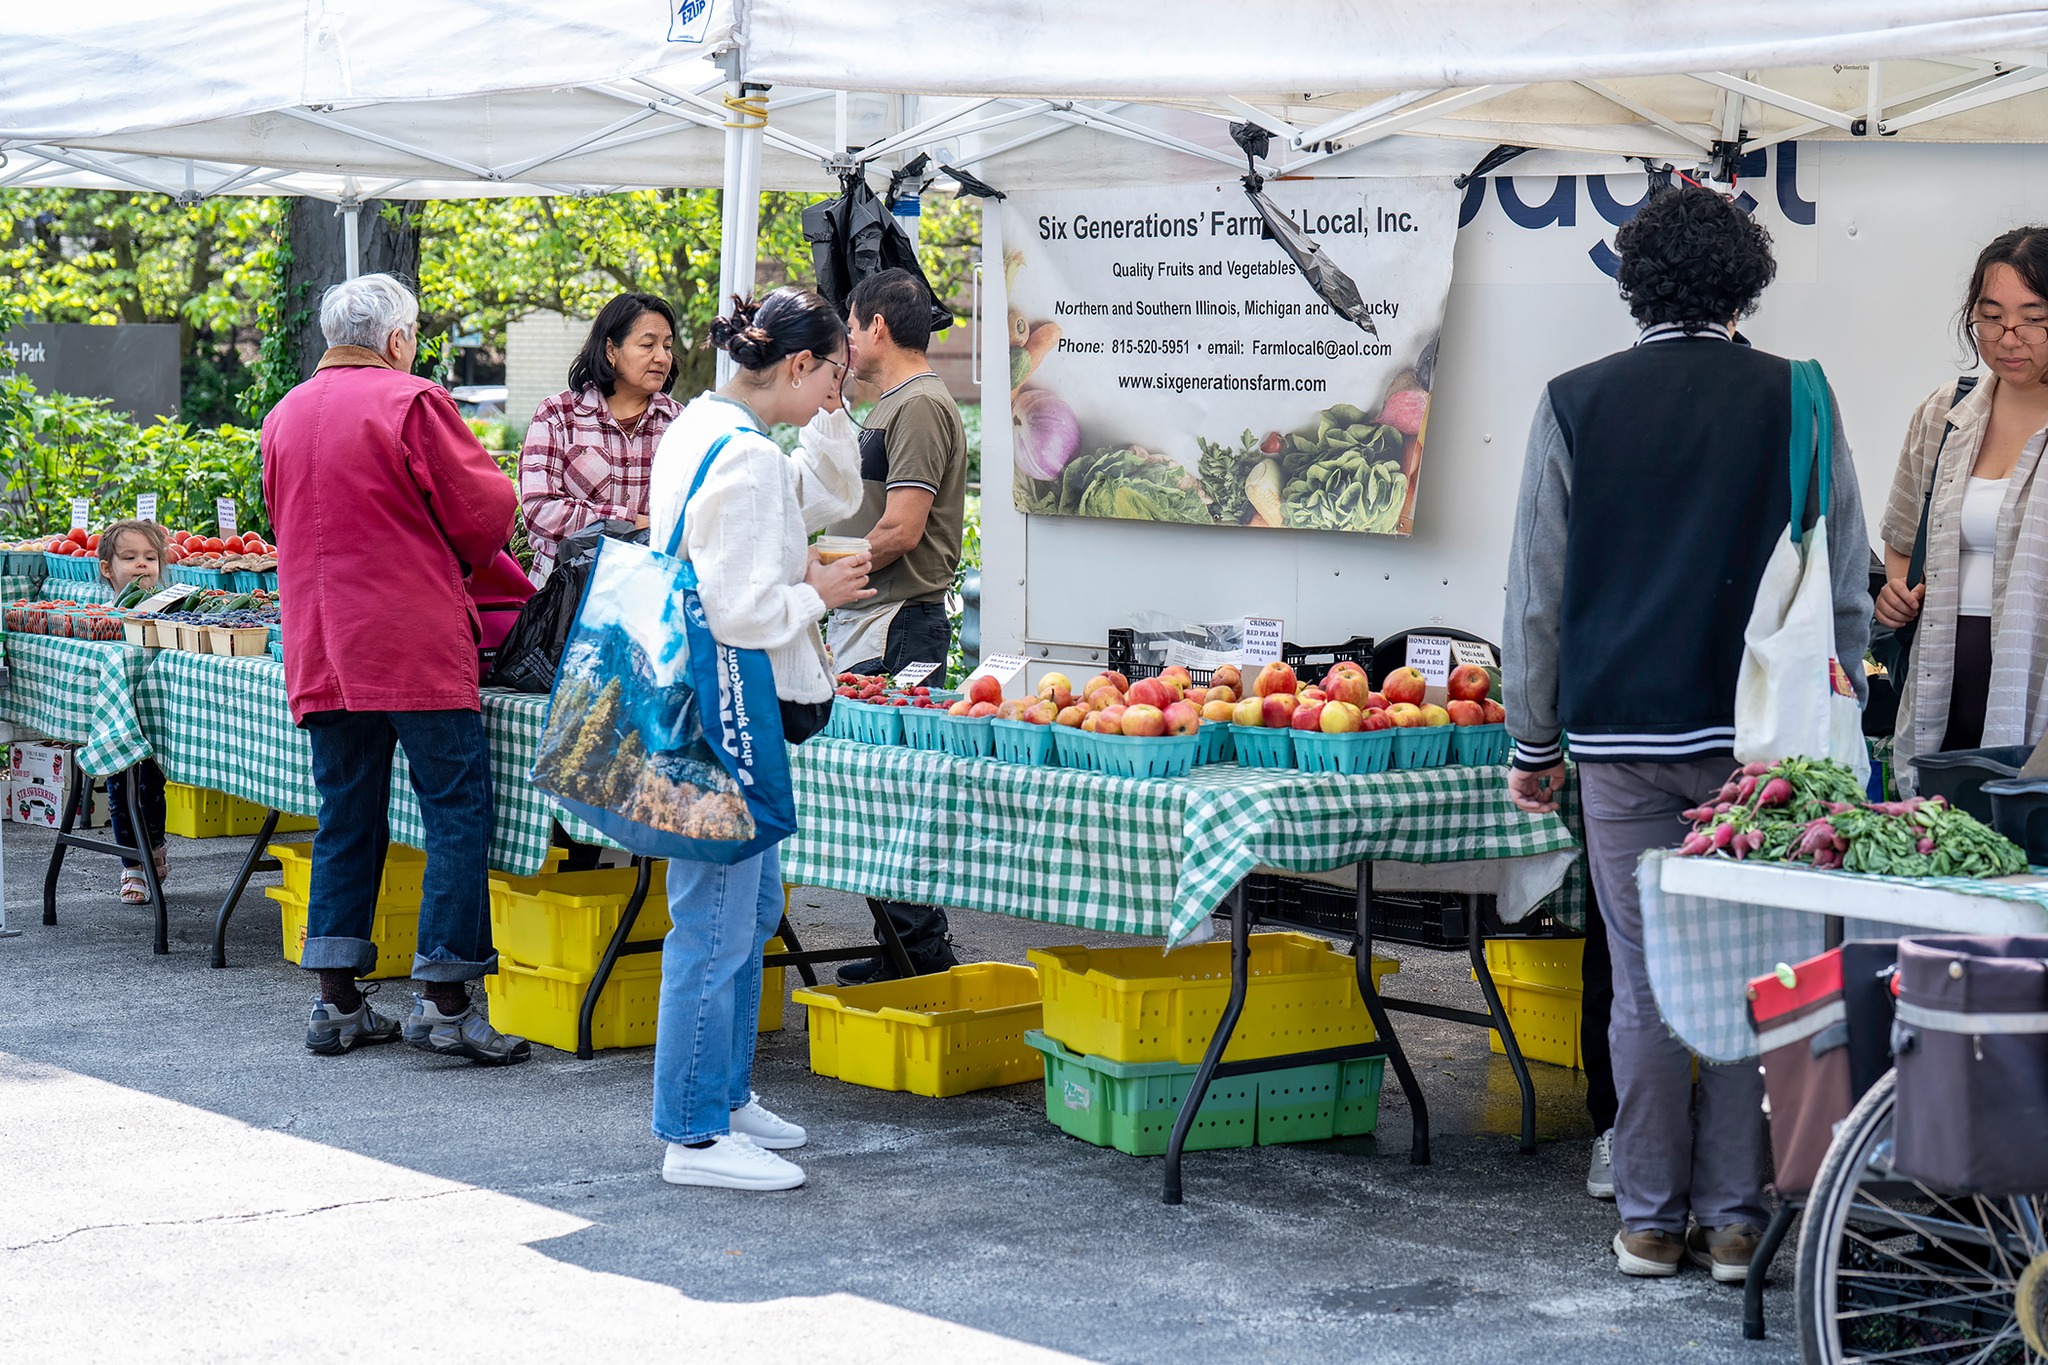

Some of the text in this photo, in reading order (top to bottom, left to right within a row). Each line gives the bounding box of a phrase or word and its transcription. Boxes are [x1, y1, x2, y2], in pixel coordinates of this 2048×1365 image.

[1039, 215, 1068, 240] Six
[1073, 211, 1205, 240] Generations'
[1303, 207, 1368, 238] Local,
[1377, 206, 1419, 233] Inc.
[1112, 261, 1154, 280] Quality
[1158, 261, 1194, 277] Fruits
[1198, 260, 1222, 276] and
[1226, 260, 1296, 279] Vegetables
[1055, 300, 1109, 316] Northern
[1112, 300, 1133, 316] and
[1136, 300, 1192, 316] Southern
[1196, 300, 1240, 317] Illinois,
[1245, 300, 1301, 319] Michigan
[1305, 300, 1329, 316] and
[22, 341, 46, 363] Park
[1058, 338, 1392, 360] Phone: 815-520-5951 email: Farmlocal6@aol.com
[1118, 372, 1327, 394] www.sixgenerationsfarm.com
[1408, 637, 1450, 646] HONEYCRISP
[1457, 642, 1482, 650] YELLOW
[1416, 648, 1441, 656] APPLES
[1460, 650, 1485, 658] SQUASH
[740, 731, 754, 766] shop
[17, 786, 57, 805] STRAWBERRIES
